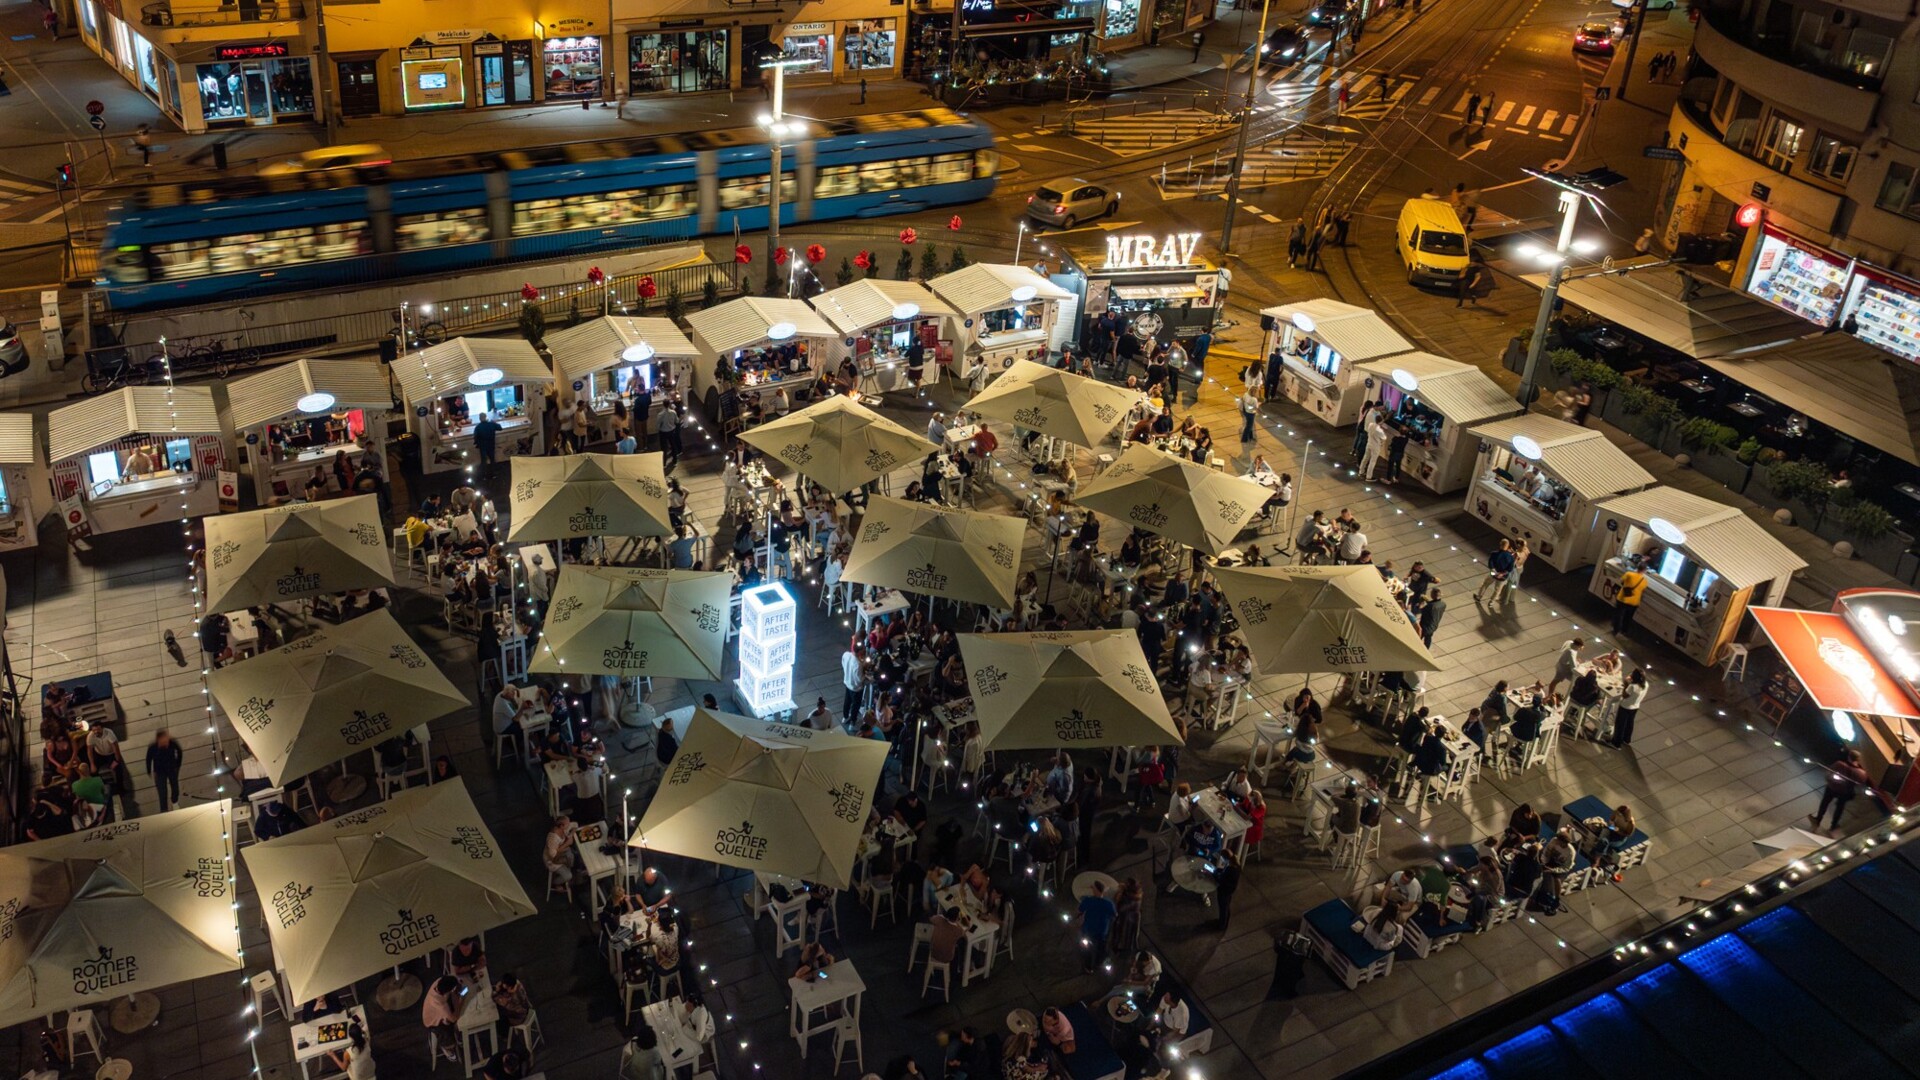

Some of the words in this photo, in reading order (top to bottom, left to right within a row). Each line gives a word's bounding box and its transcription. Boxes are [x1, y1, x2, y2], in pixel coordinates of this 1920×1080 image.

[222, 46, 276, 56] AMADEUS
[1104, 232, 1202, 268] MRAV
[1014, 414, 1044, 428] QUELLE
[780, 450, 806, 466] QUELLE
[870, 456, 898, 472] QUELLE
[570, 522, 607, 532] QUELLE
[1130, 510, 1164, 529] QUELLE
[278, 582, 321, 595] QUELLE
[906, 577, 946, 590] QUELLE
[709, 606, 720, 634] QUELLE
[764, 612, 790, 626] AFTER
[765, 624, 789, 636] TASTE
[770, 641, 791, 658] AFTER
[602, 658, 646, 669] QUELLE
[770, 652, 790, 668] TASTE
[1326, 654, 1368, 666] QUELLE
[761, 678, 786, 690] AFTER
[974, 668, 992, 697] QUELLE
[762, 688, 786, 700] TASTE
[237, 704, 263, 734] QUELLE
[346, 722, 392, 745] QUELLE
[1057, 729, 1102, 742] QUELLE
[668, 753, 690, 786] QUELLE
[846, 788, 864, 824] QUELLE
[468, 825, 492, 859] QUELLE
[714, 842, 764, 861] QUELLE
[211, 858, 226, 898] QUELLE
[272, 891, 296, 929] QUELLE
[384, 926, 440, 956] QUELLE
[74, 970, 136, 995] QUELLE
